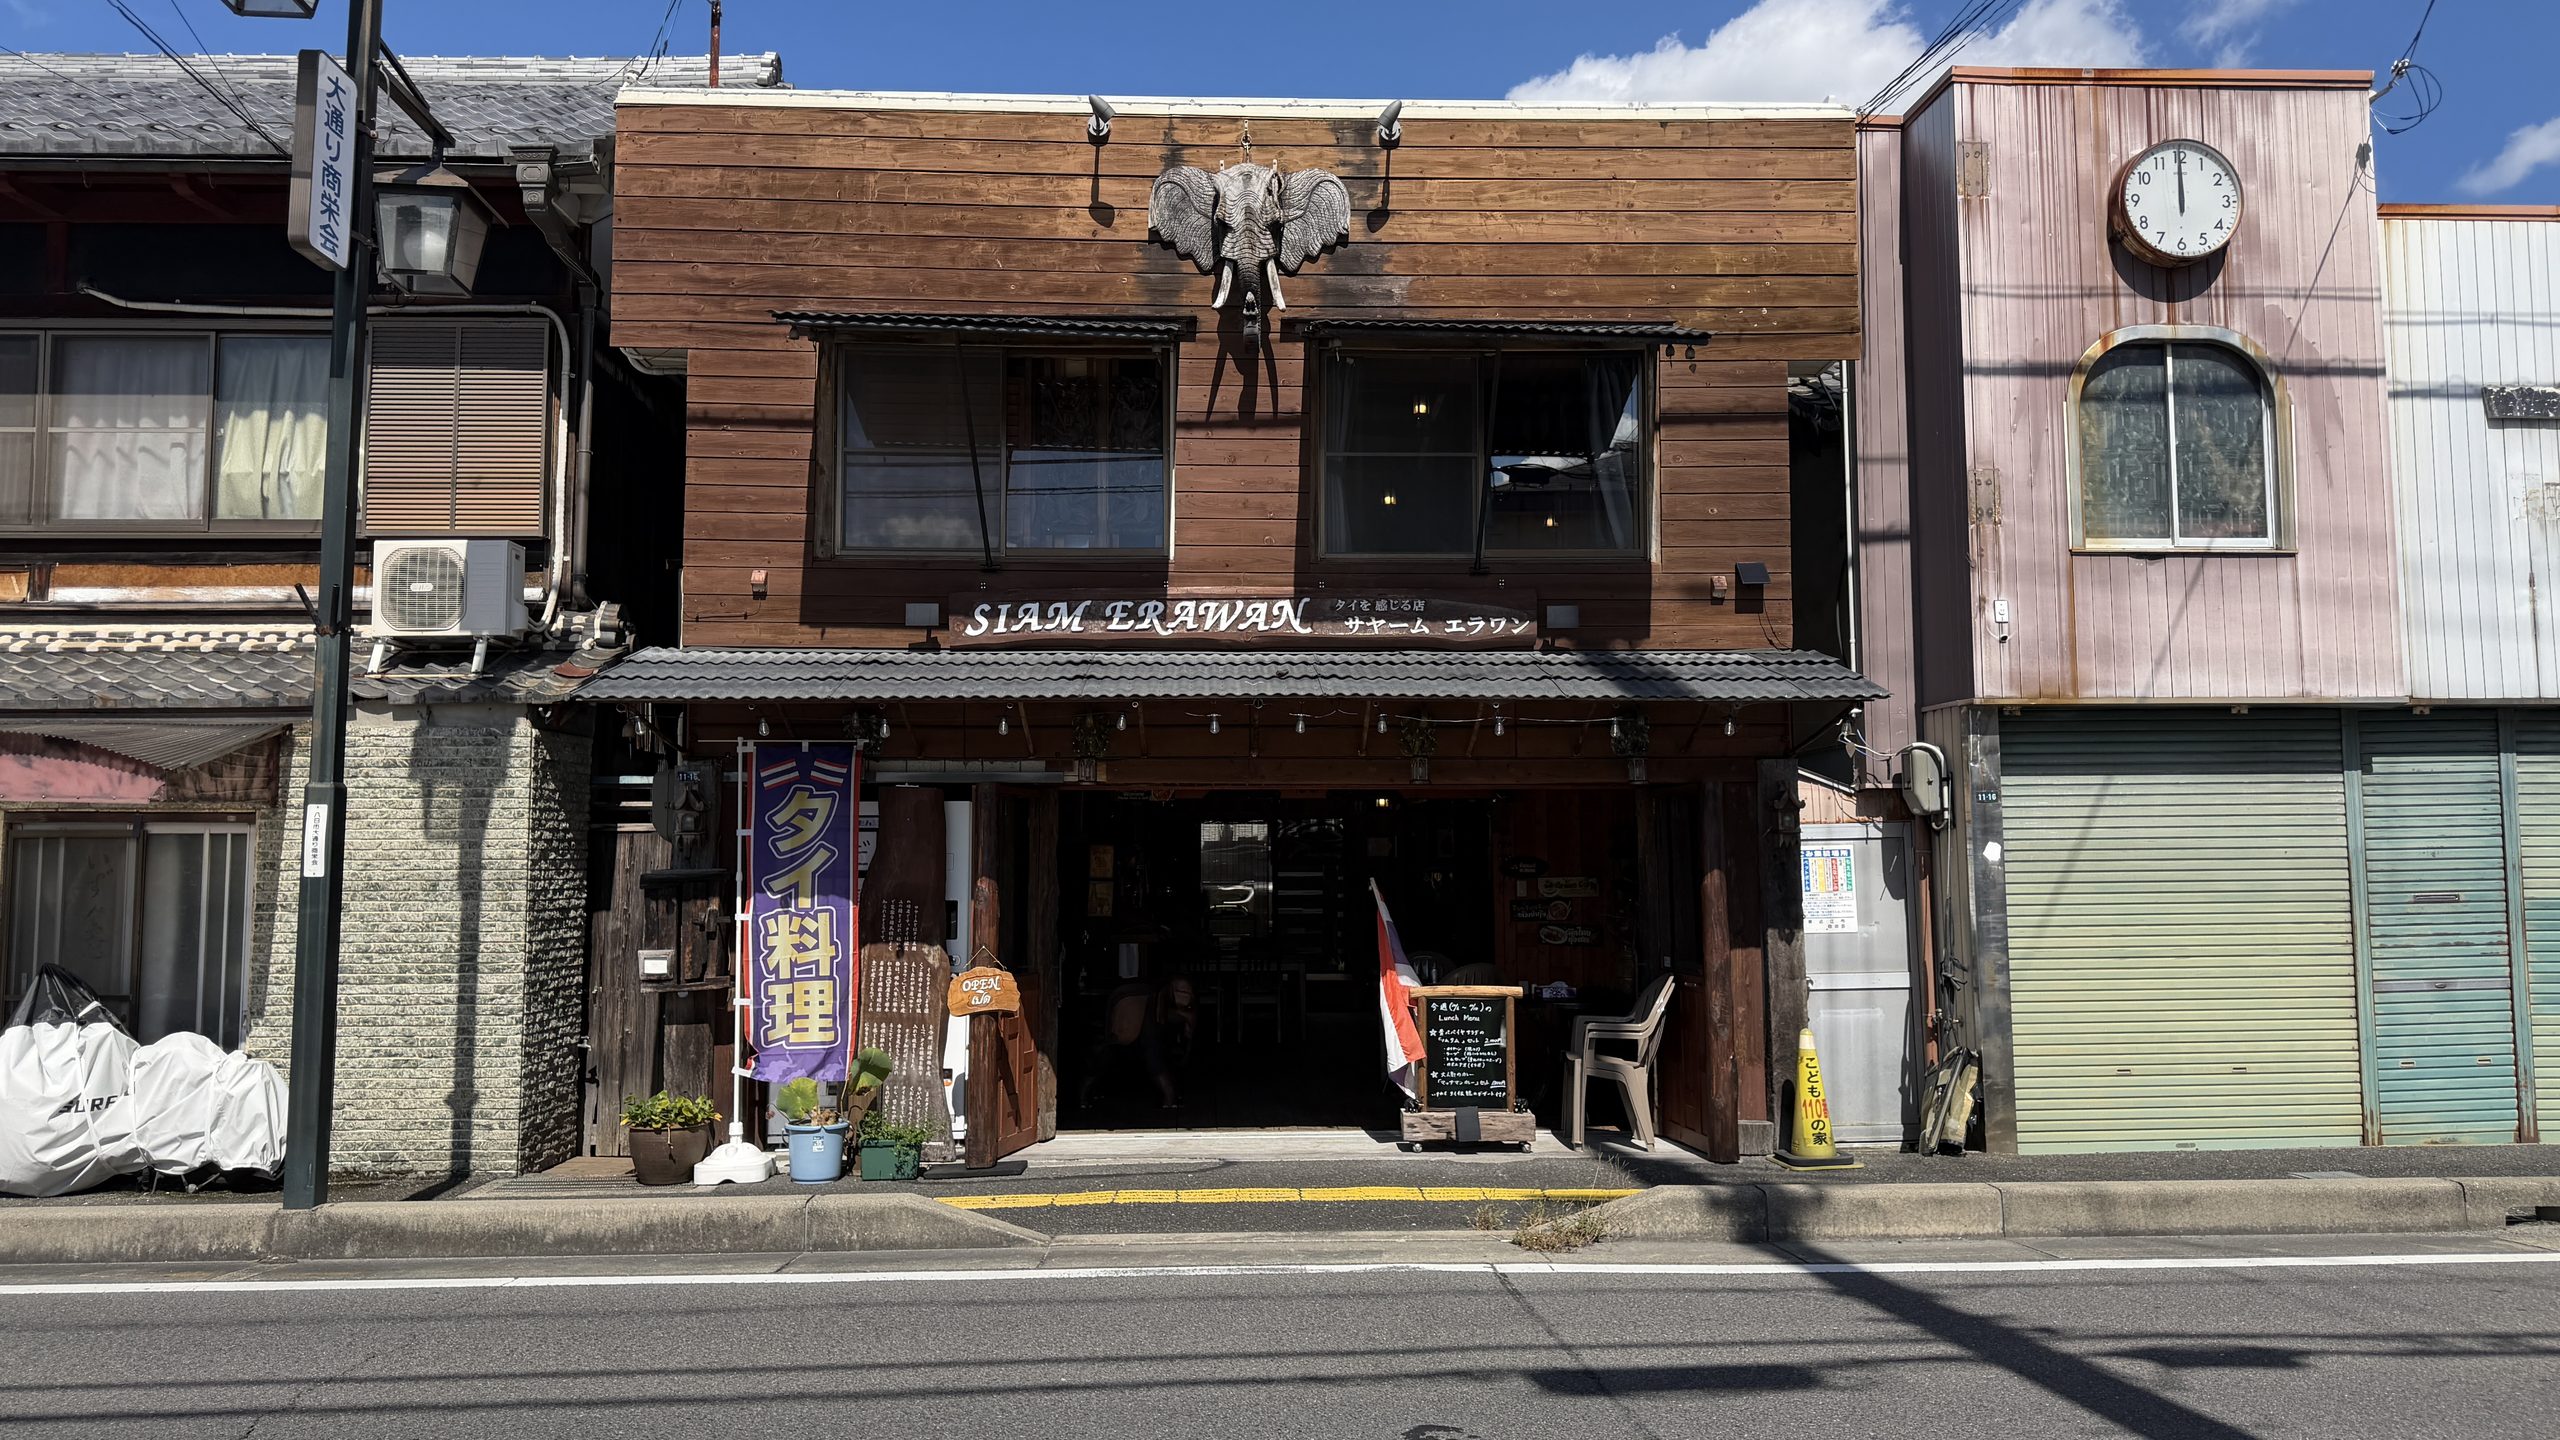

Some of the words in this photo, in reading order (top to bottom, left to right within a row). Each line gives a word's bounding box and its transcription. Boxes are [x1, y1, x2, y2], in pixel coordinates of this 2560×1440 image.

[320, 75, 346, 258] 大通り商栄会
[2154, 157, 2164, 170] 11
[2199, 158, 2204, 171] 1
[2138, 172, 2150, 185] 10
[2213, 173, 2222, 186] 2
[2131, 194, 2140, 207] 9
[2222, 196, 2230, 208] 3
[2140, 216, 2148, 229] 8
[2214, 218, 2223, 230] 4
[2157, 232, 2165, 244] 7
[2177, 238, 2186, 250] 6
[2199, 233, 2207, 245] 5
[1335, 600, 1371, 612] タイを
[1375, 600, 1426, 612] 感じる店
[964, 600, 1094, 636] SIAM
[1105, 597, 1313, 636] ERAWAN
[1344, 616, 1430, 634] サヤーム
[1444, 616, 1530, 636] エラワン
[763, 786, 838, 1046] タイ料理
[962, 975, 1002, 992] OPEN
[972, 990, 991, 1005] เปิด
